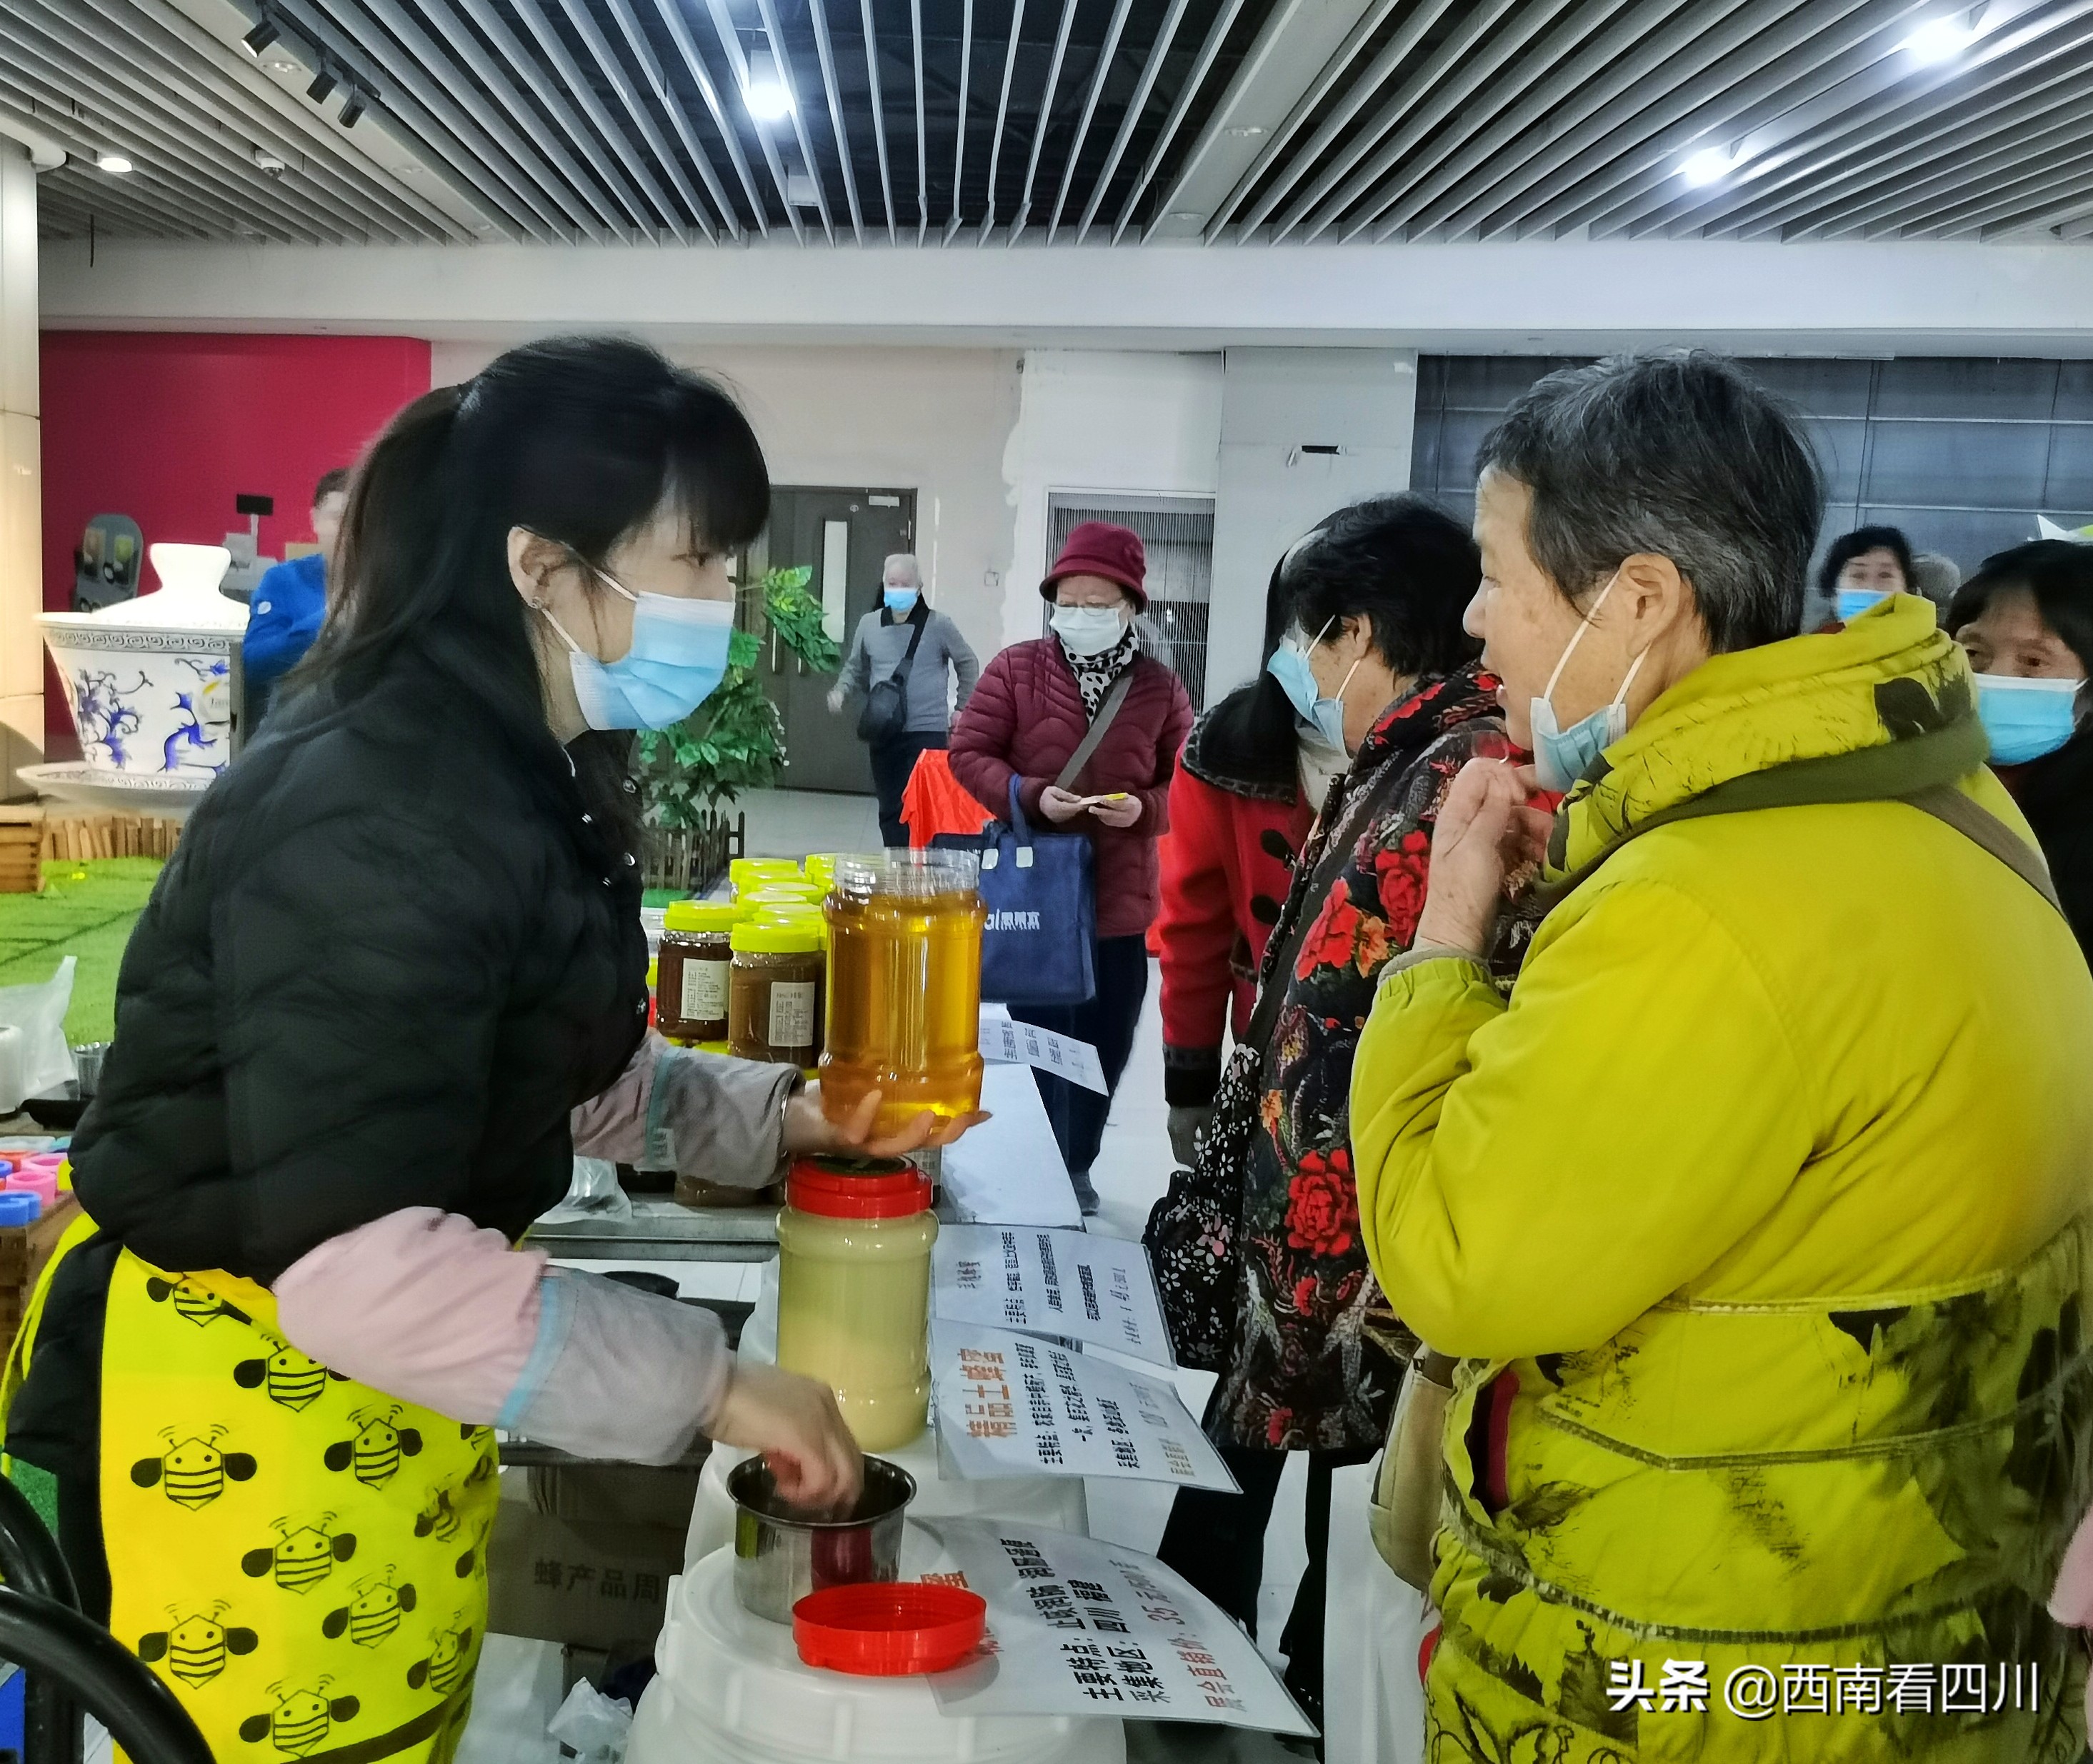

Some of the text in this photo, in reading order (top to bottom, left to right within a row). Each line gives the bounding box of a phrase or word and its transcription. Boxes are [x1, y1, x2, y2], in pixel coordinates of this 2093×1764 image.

[957, 1348, 1018, 1438] 精品土蜂蜜
